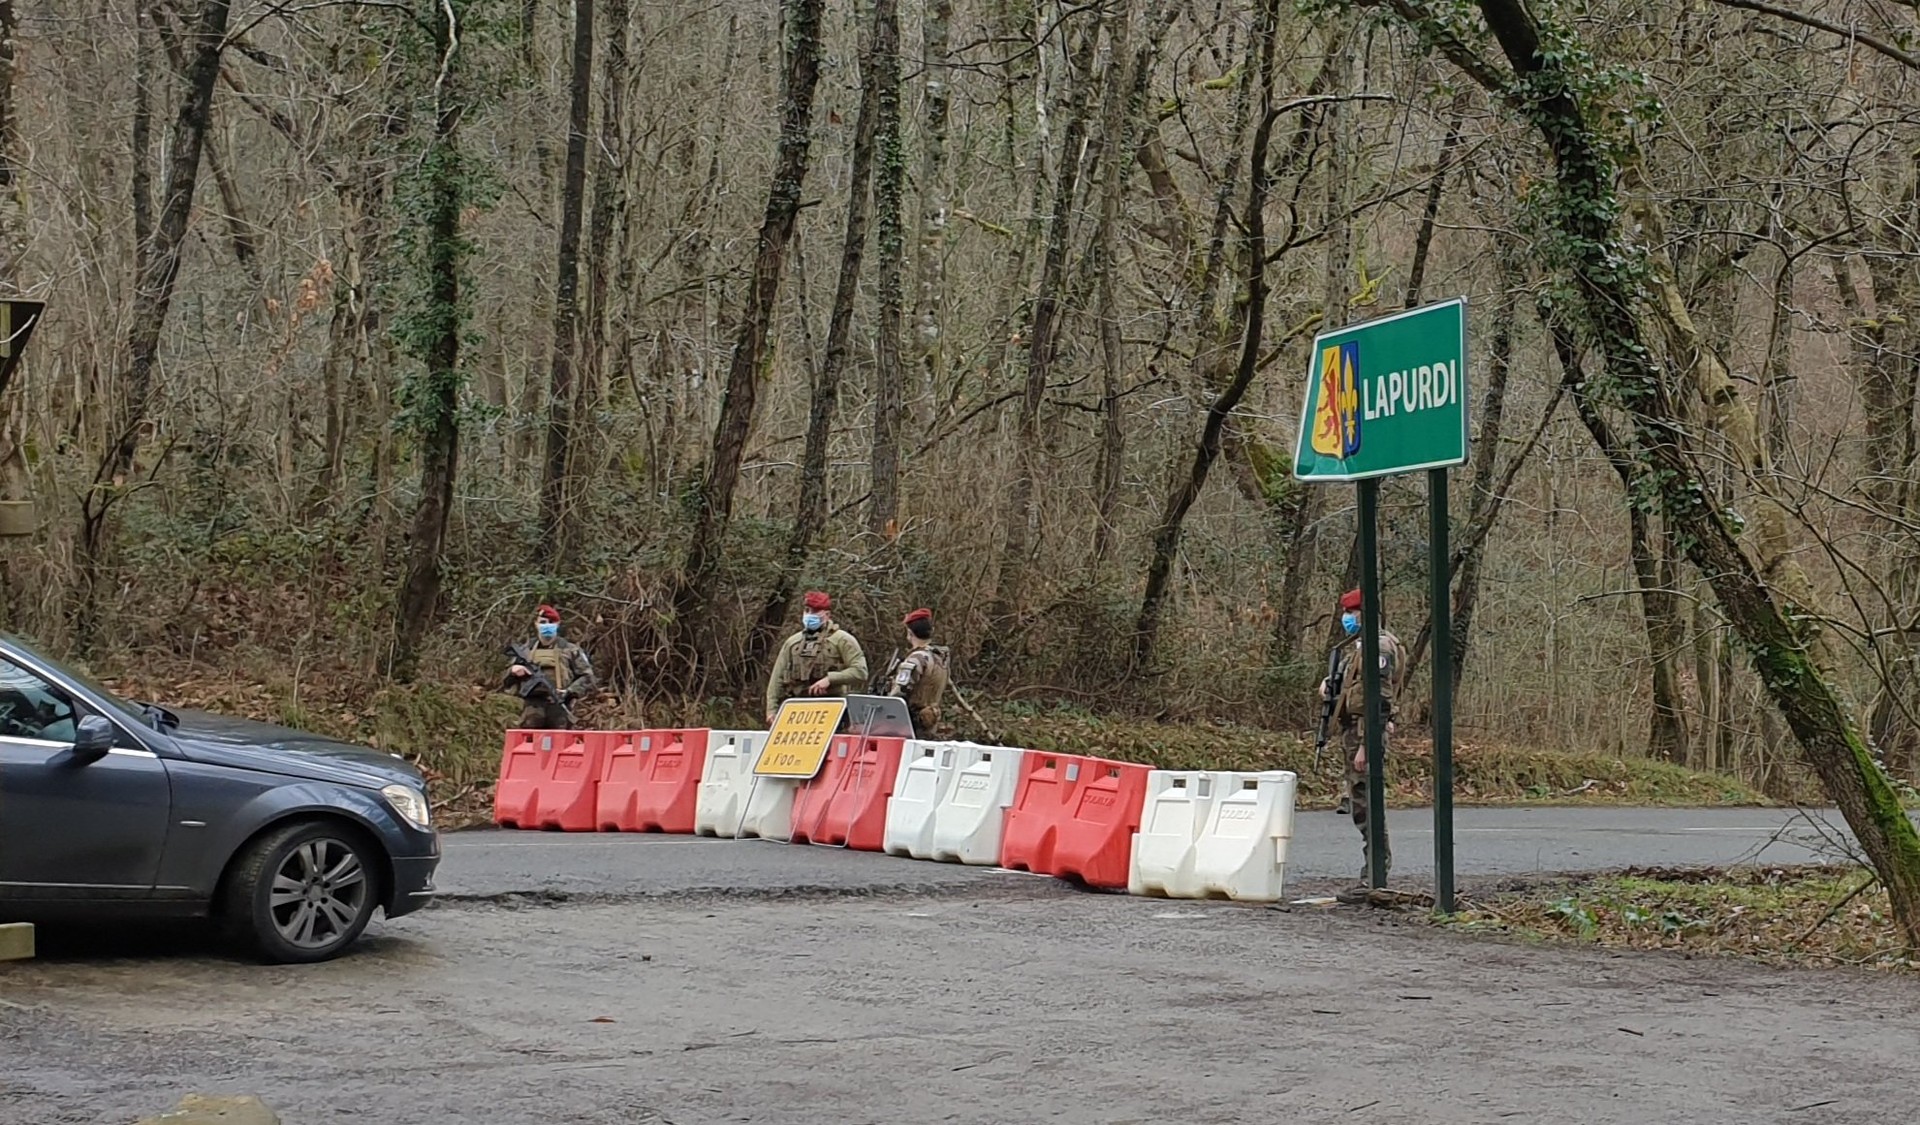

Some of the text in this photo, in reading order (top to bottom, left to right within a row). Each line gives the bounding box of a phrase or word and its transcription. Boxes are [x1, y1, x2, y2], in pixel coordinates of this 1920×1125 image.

[1363, 359, 1456, 420] LAPURDI
[786, 710, 829, 725] ROUTE
[772, 728, 824, 745] BARRÉE
